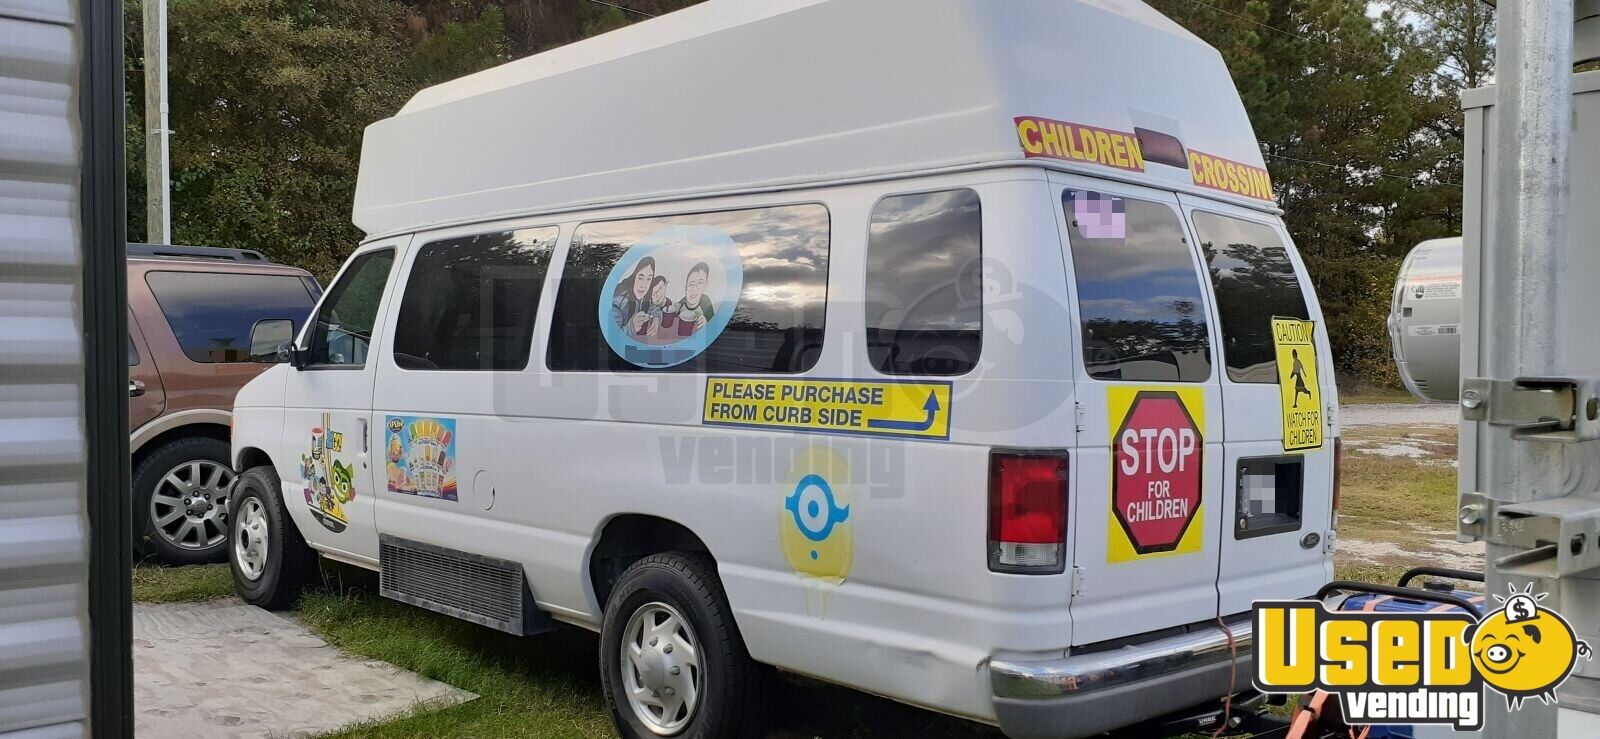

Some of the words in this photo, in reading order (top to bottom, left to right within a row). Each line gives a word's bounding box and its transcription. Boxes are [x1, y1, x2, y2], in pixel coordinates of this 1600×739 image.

[1018, 119, 1144, 169] CHILDREN
[1275, 323, 1309, 342] CAUTION
[712, 383, 776, 401] PLEASE
[780, 385, 884, 406] PURCHASE
[710, 402, 758, 421] FROM
[763, 405, 812, 424] CURB
[817, 408, 863, 427] SIDE
[1287, 411, 1306, 428] WATCH
[1307, 411, 1319, 427] FOR
[1289, 429, 1317, 446] CHILDREN
[1120, 427, 1195, 476] STOP
[1147, 480, 1170, 499] FOR
[1127, 498, 1188, 523] CHILDREN
